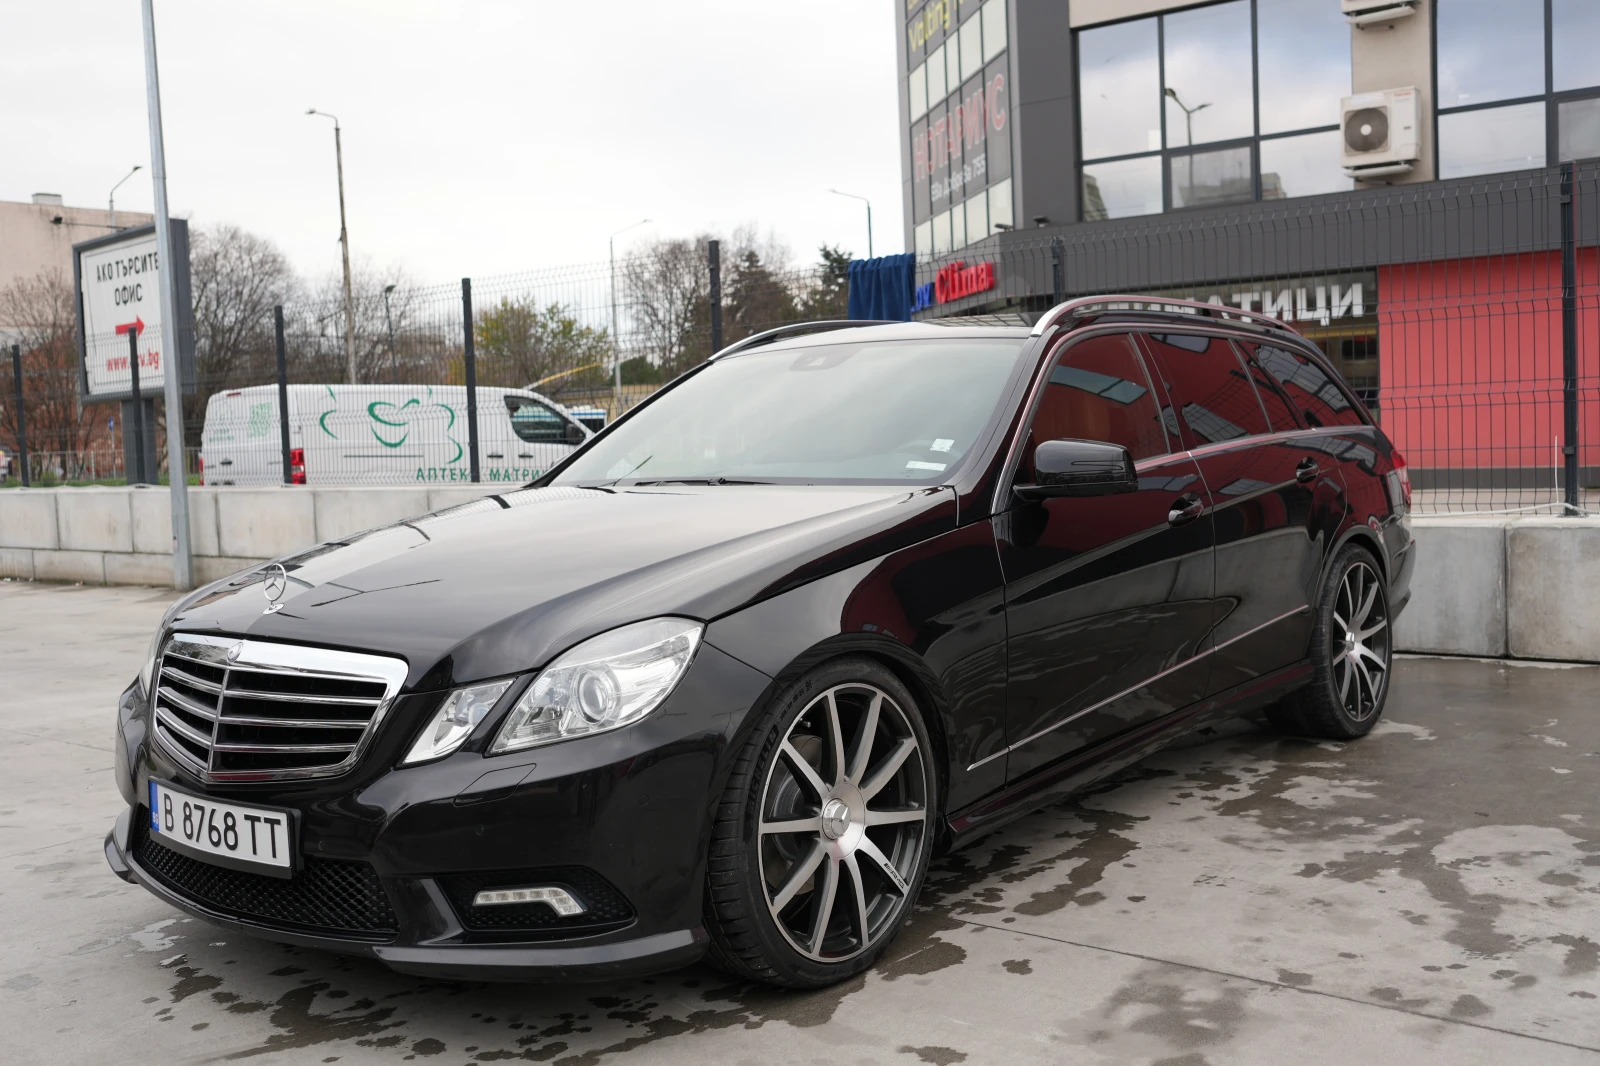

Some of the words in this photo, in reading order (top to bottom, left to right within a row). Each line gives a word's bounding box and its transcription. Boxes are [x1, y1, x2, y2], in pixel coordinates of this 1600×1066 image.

[914, 73, 1006, 183] НОТАРИУС
[96, 263, 113, 283] АКО
[115, 252, 158, 278] ТЪРСИТЕ
[115, 283, 143, 306] ОФИС
[416, 467, 469, 481] АПТЕК
[164, 792, 175, 832] B
[183, 801, 239, 851] 8768
[244, 813, 282, 859] TT
